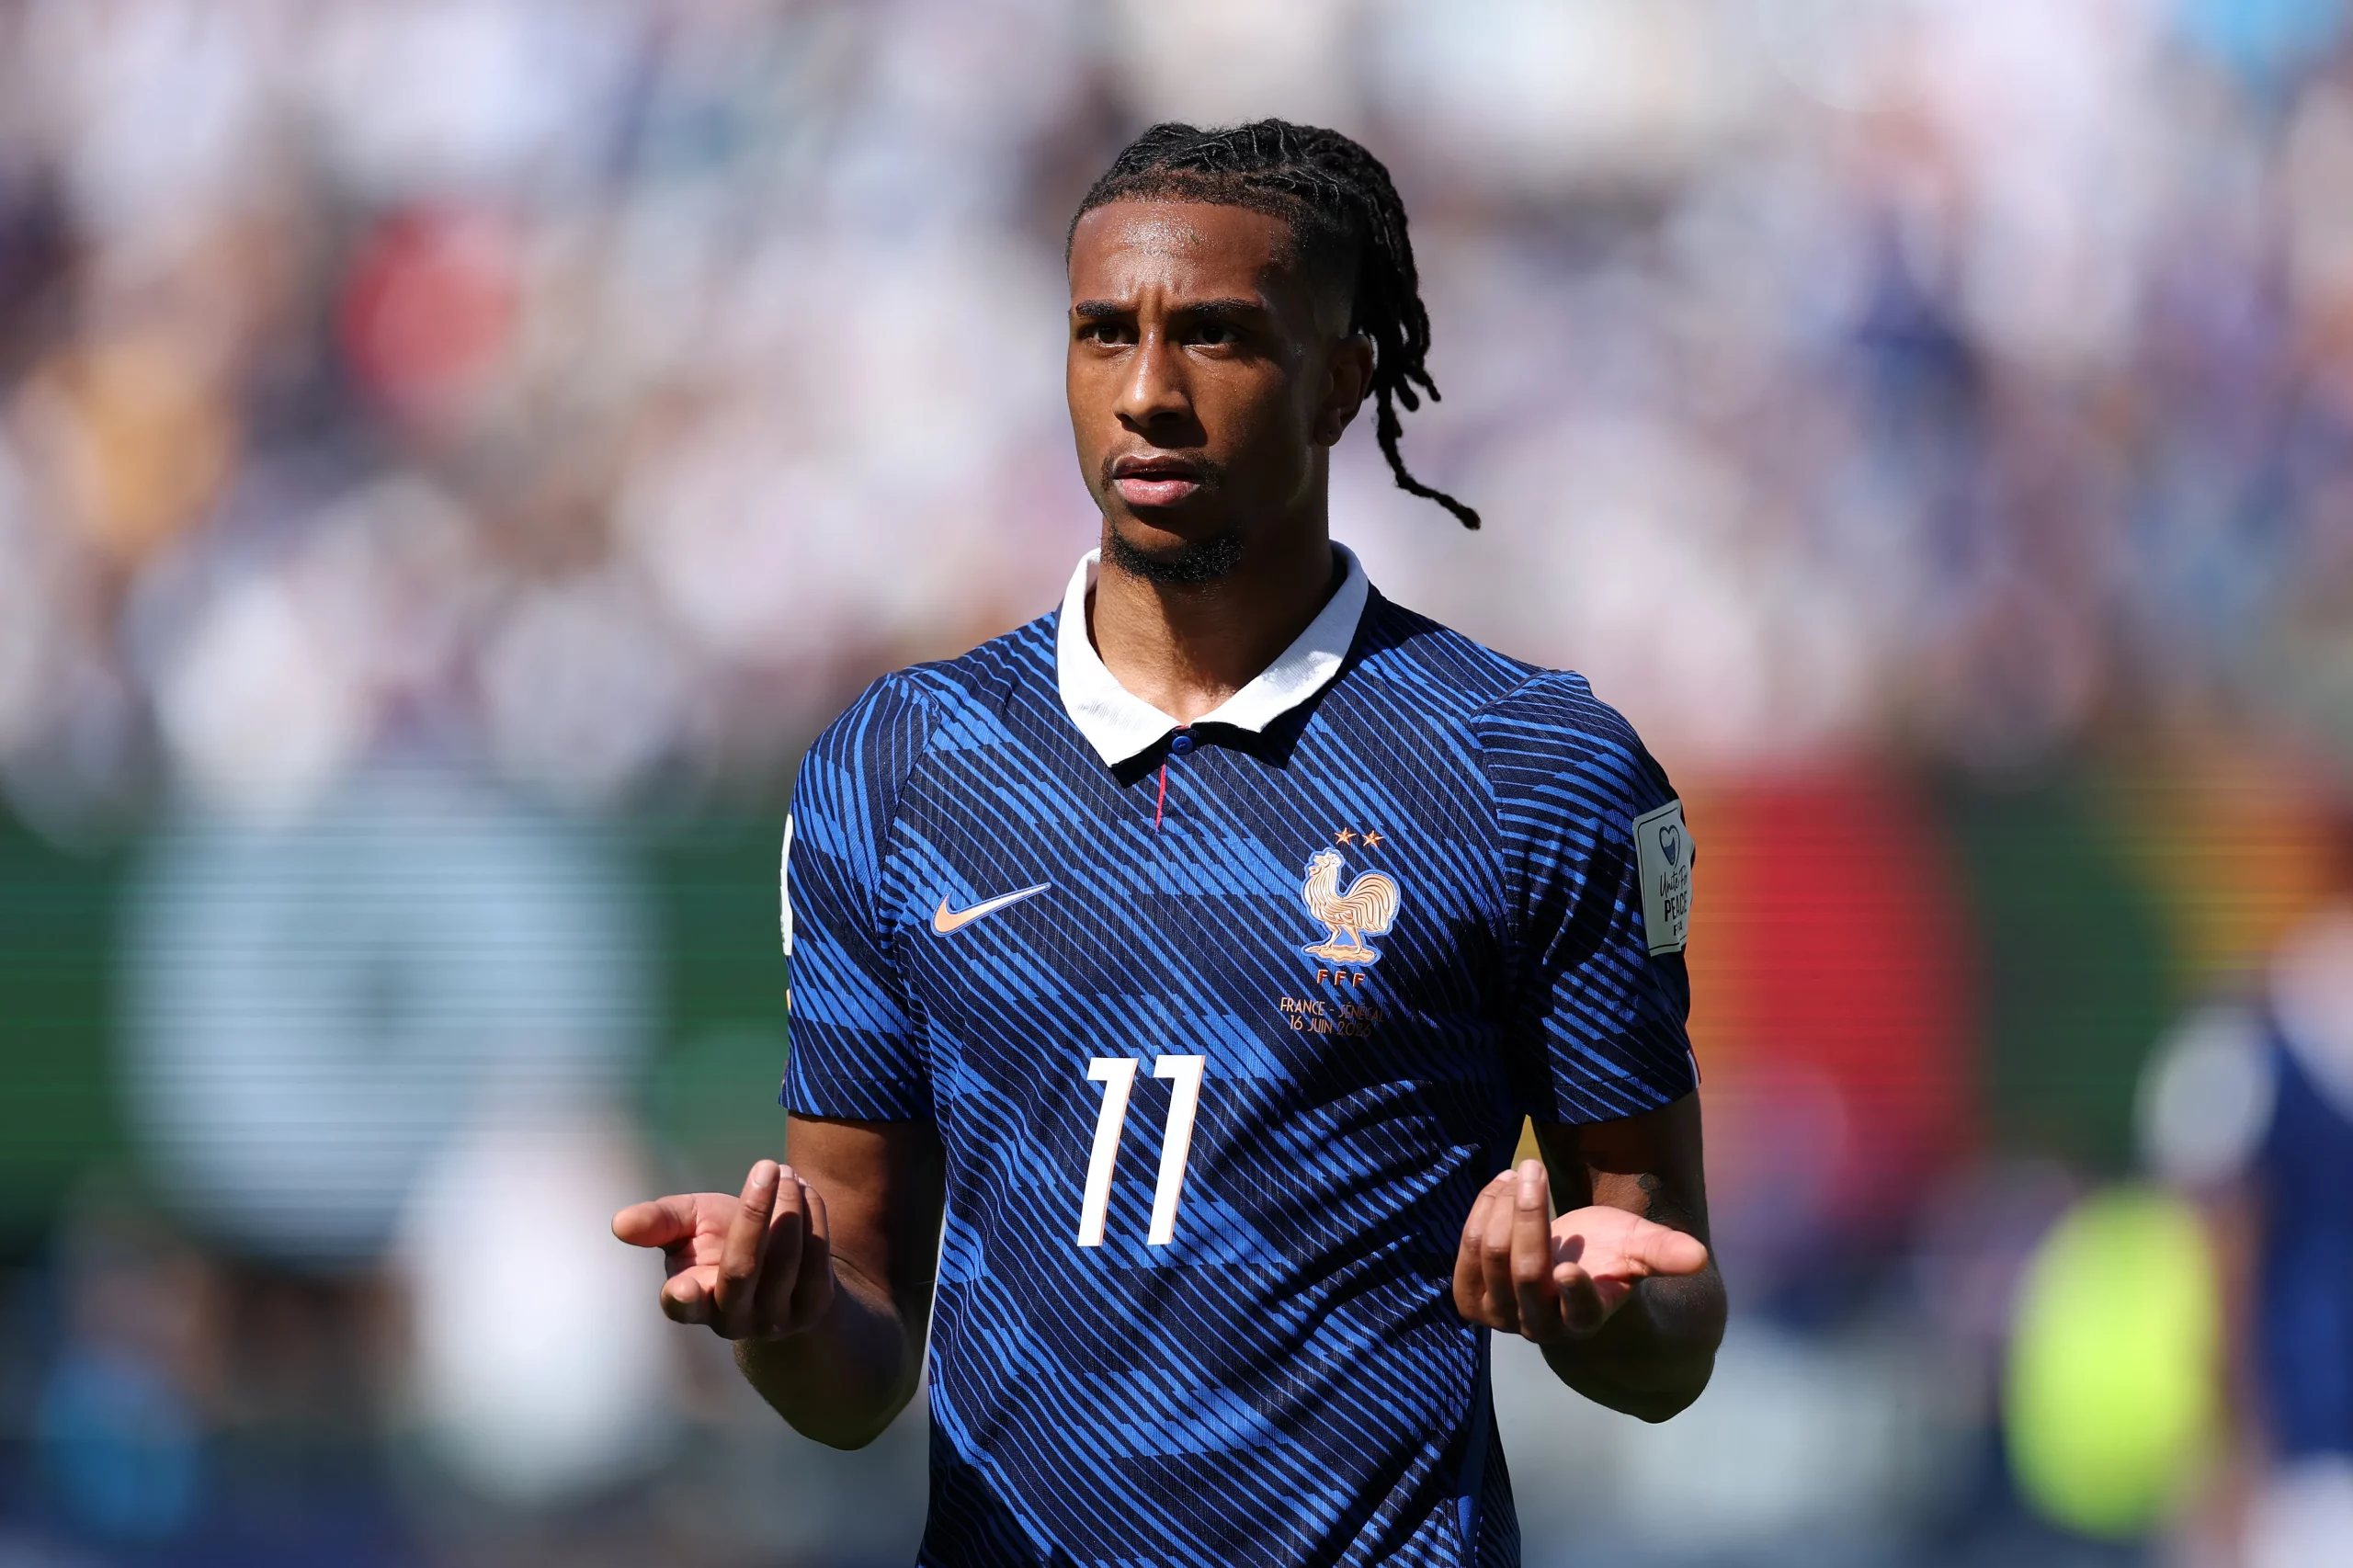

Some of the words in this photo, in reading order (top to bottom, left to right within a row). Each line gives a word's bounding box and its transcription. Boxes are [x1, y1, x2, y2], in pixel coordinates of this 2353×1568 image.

[1660, 871, 1679, 898] Unite
[1665, 891, 1688, 922] PEACE
[1279, 997, 1325, 1016] FRANCE
[1290, 1015, 1304, 1030] 16
[1307, 1017, 1334, 1035] JUIN
[1336, 1020, 1371, 1038] 2026
[1077, 1054, 1206, 1247] 11
